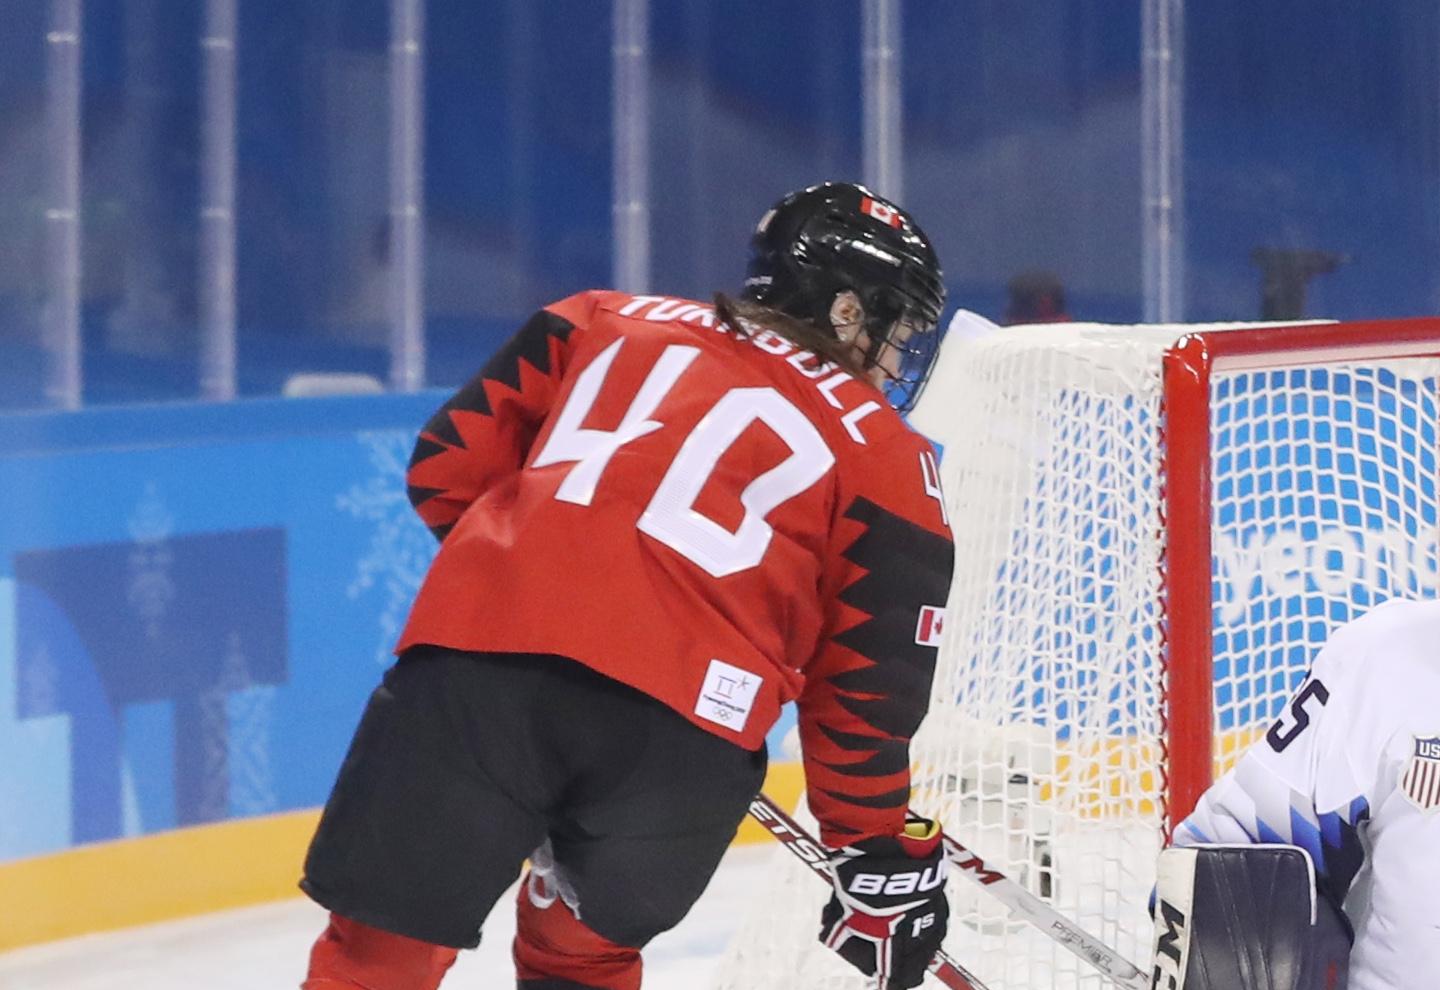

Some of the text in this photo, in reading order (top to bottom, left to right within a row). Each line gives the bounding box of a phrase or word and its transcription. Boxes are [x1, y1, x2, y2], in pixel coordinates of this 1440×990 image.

[618, 296, 882, 446] TURBULL
[532, 336, 836, 578] 40
[919, 450, 949, 526] 4
